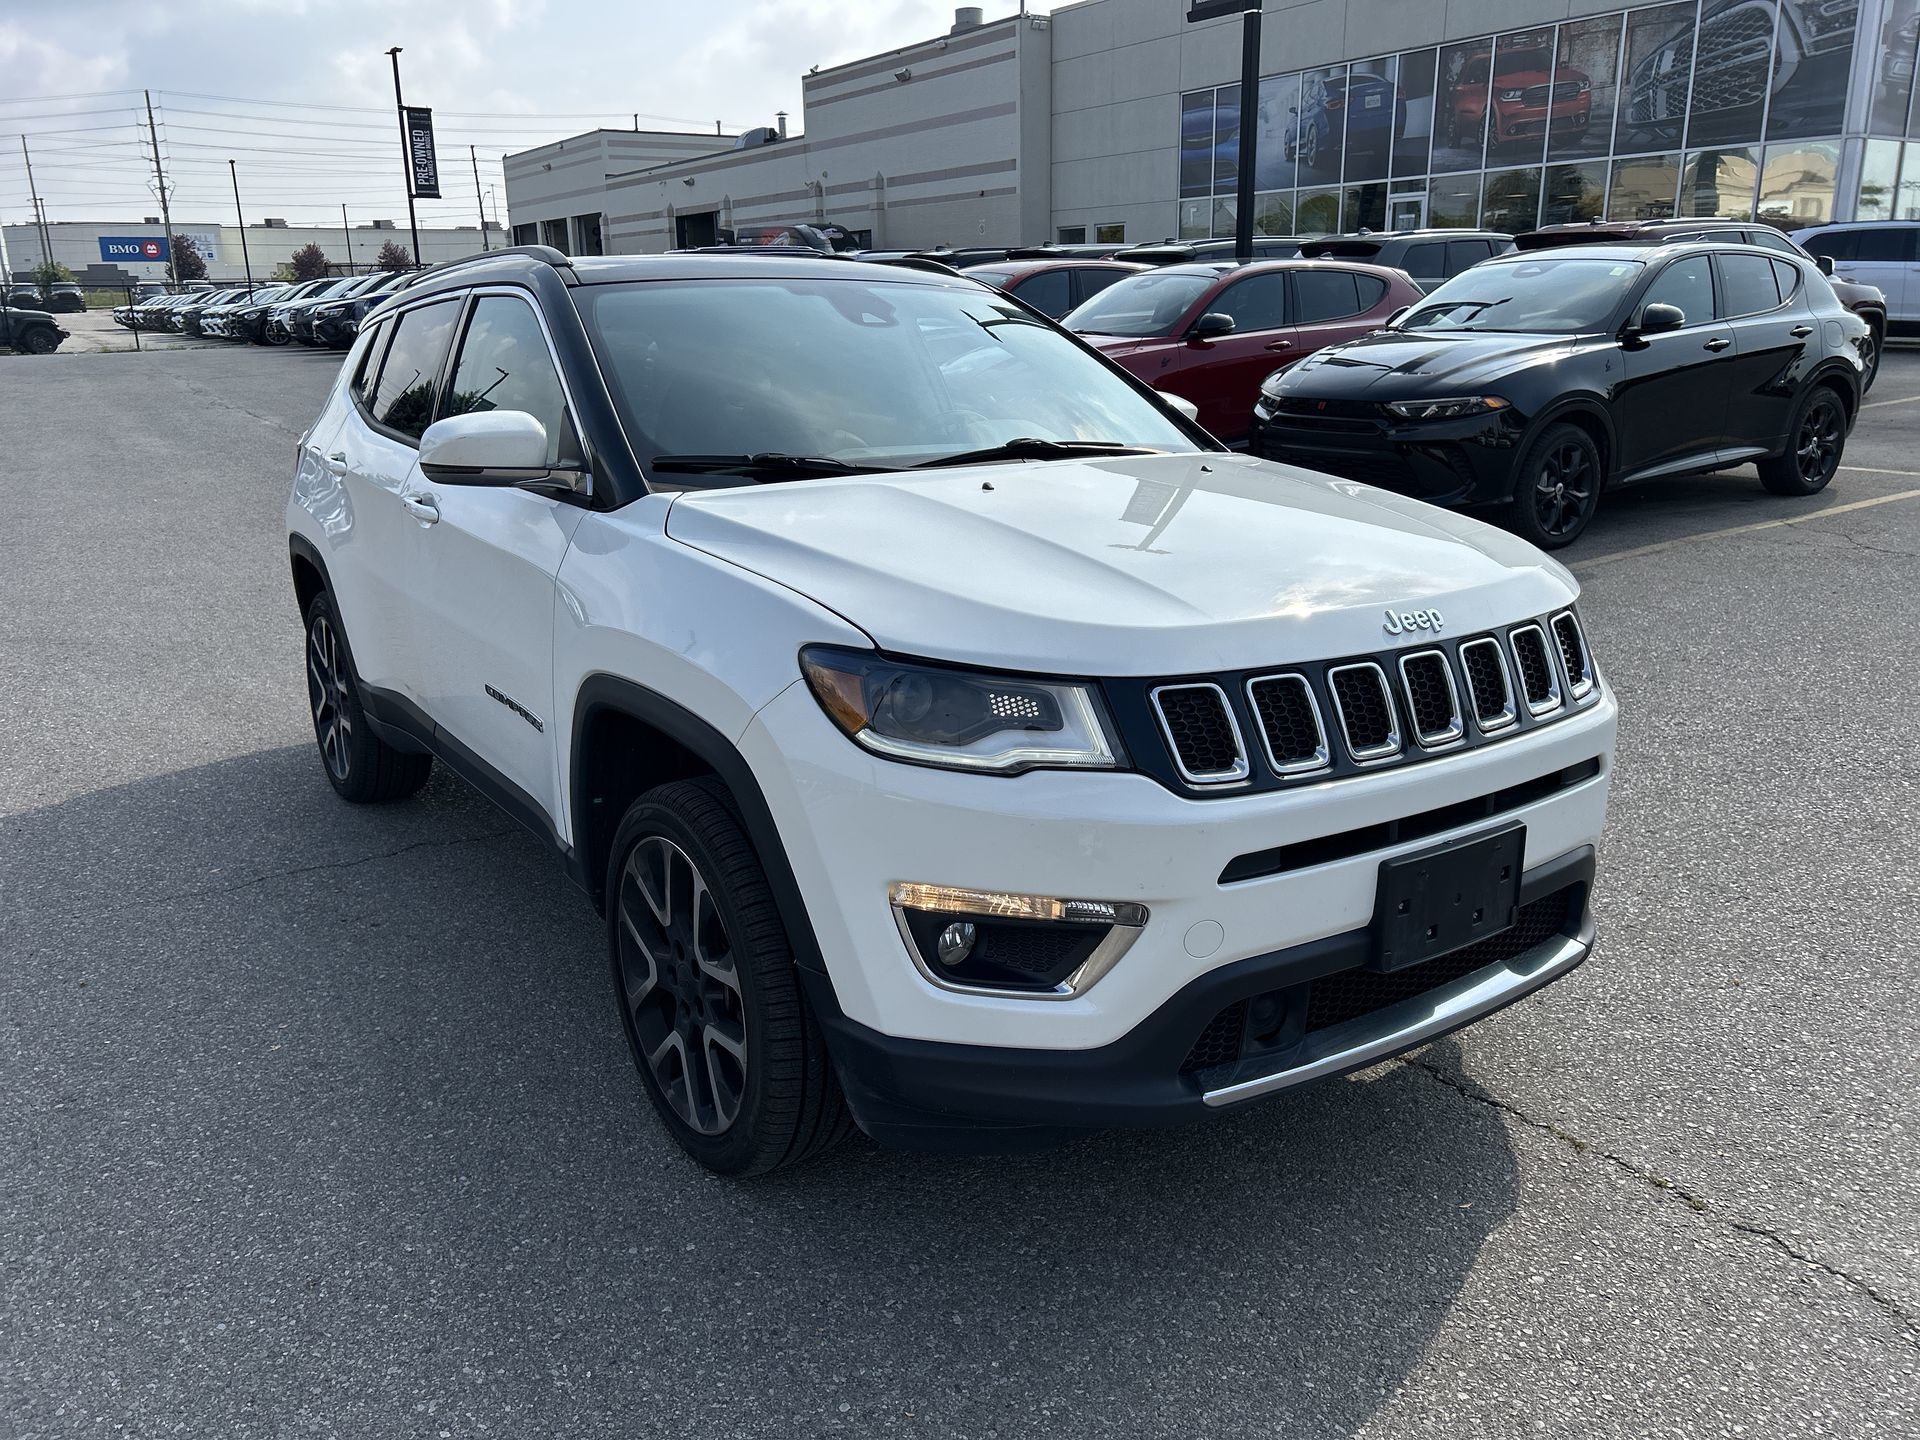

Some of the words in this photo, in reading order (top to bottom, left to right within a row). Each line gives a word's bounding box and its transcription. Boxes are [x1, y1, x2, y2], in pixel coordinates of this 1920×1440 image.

[1707, 76, 1757, 92] DODGE
[412, 129, 430, 185] PRE-OWNED
[108, 244, 140, 254] BMO
[1382, 608, 1445, 636] Jeep
